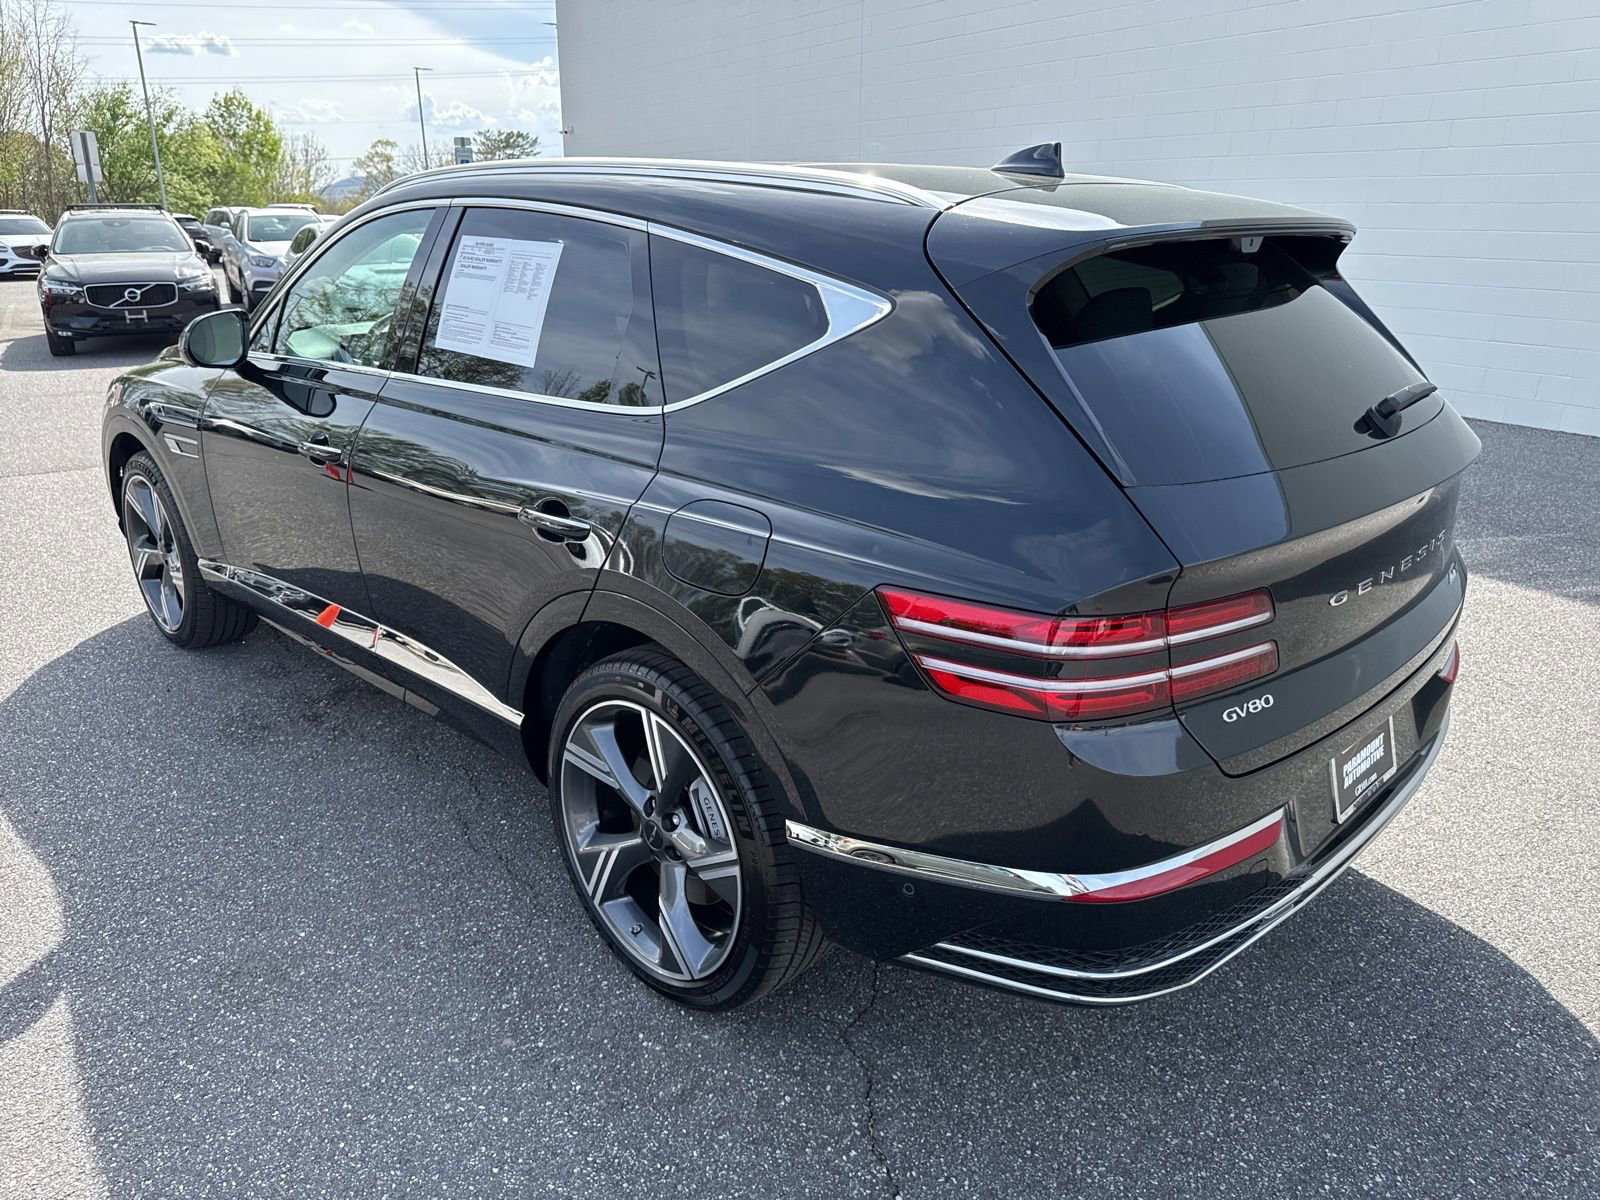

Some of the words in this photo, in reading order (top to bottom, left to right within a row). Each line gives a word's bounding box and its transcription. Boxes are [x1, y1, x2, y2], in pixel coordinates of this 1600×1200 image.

[1329, 529, 1446, 606] GENESIS
[1222, 694, 1274, 722] GV80
[680, 715, 752, 835] MICHELIN
[1343, 732, 1384, 778] PARAMOUNT
[1344, 745, 1384, 789] AUTOMOTIVE
